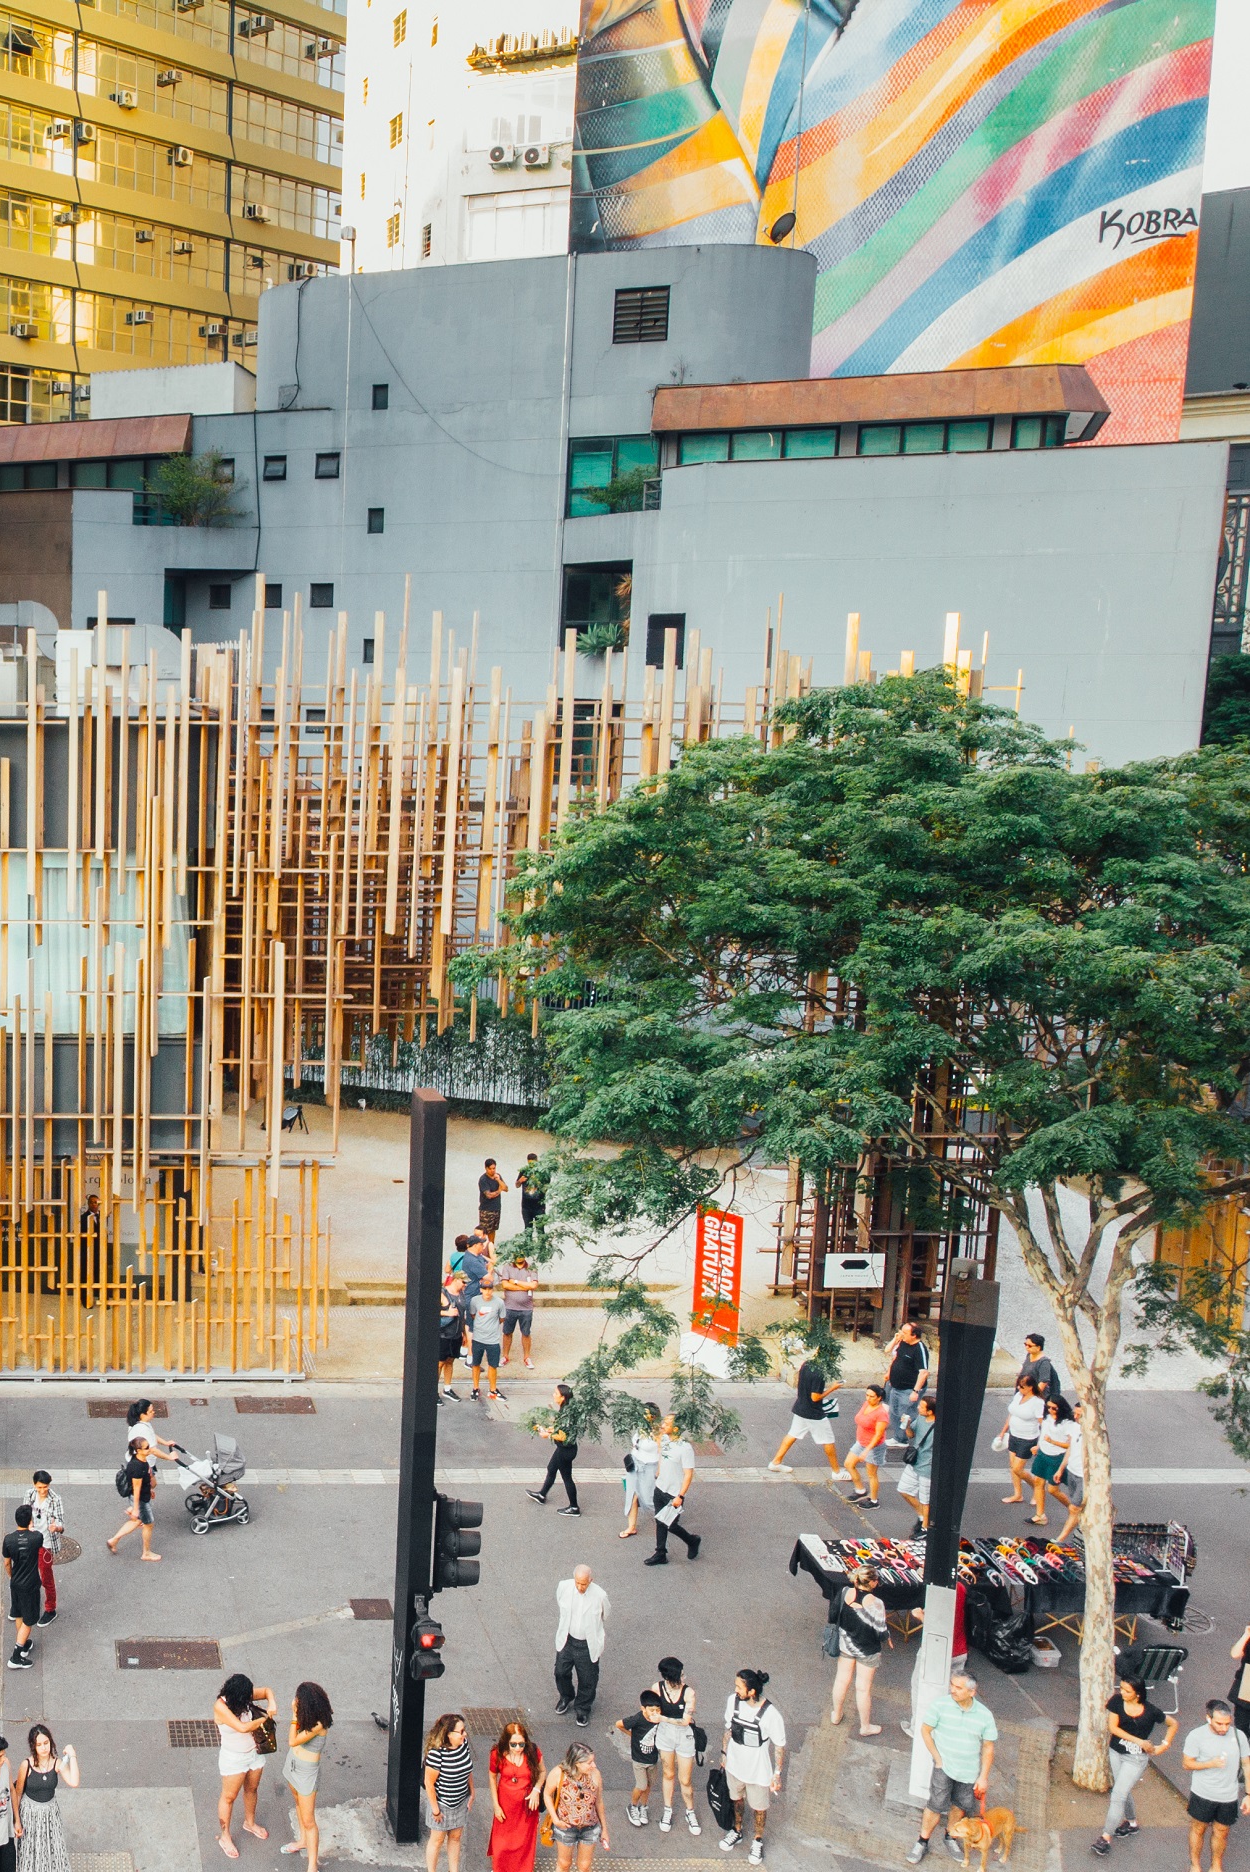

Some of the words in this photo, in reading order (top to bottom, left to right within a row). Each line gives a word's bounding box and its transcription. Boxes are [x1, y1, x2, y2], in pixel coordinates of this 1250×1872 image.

[1099, 207, 1199, 250] KOBRA
[701, 1215, 721, 1298] GRATUITA
[718, 1221, 736, 1301] ENTRADA
